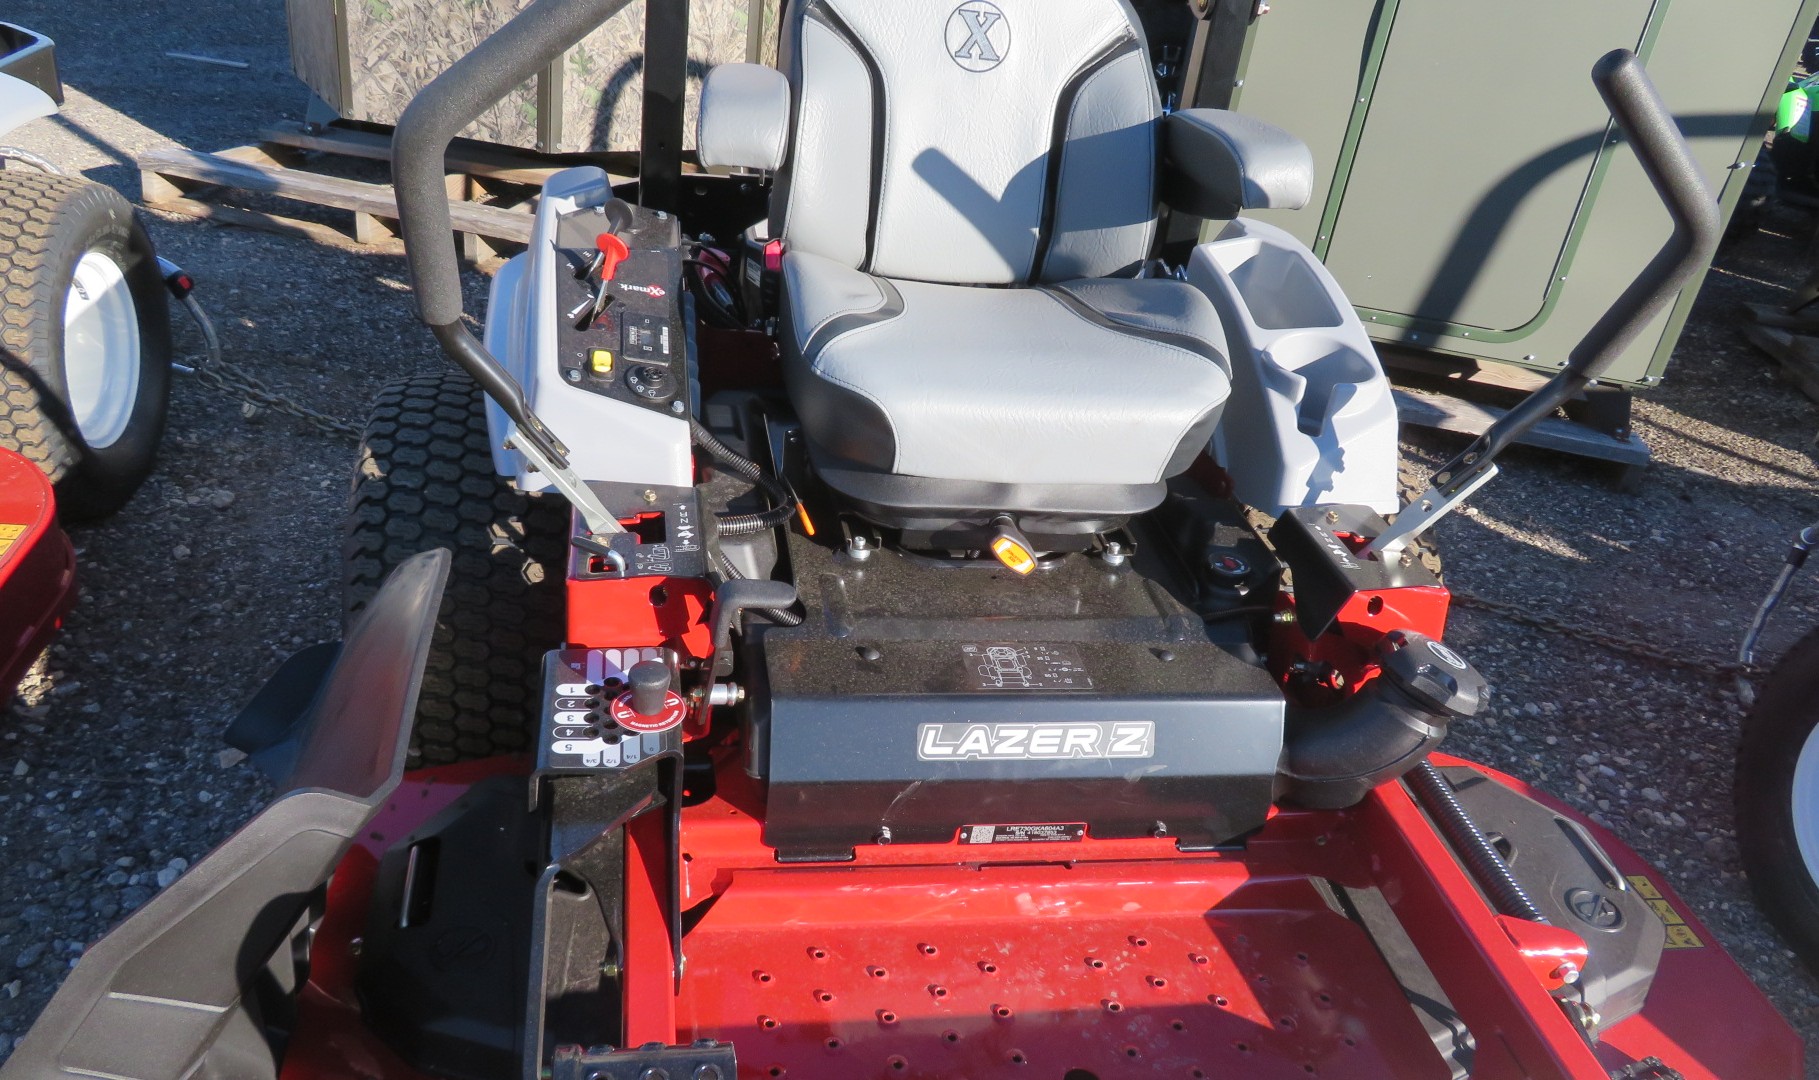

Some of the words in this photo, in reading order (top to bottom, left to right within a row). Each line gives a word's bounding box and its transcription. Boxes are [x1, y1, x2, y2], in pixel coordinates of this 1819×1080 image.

[954, 8, 1002, 62] X
[568, 700, 575, 708] 2
[919, 724, 1101, 758] LAZER
[1109, 725, 1149, 755] Z
